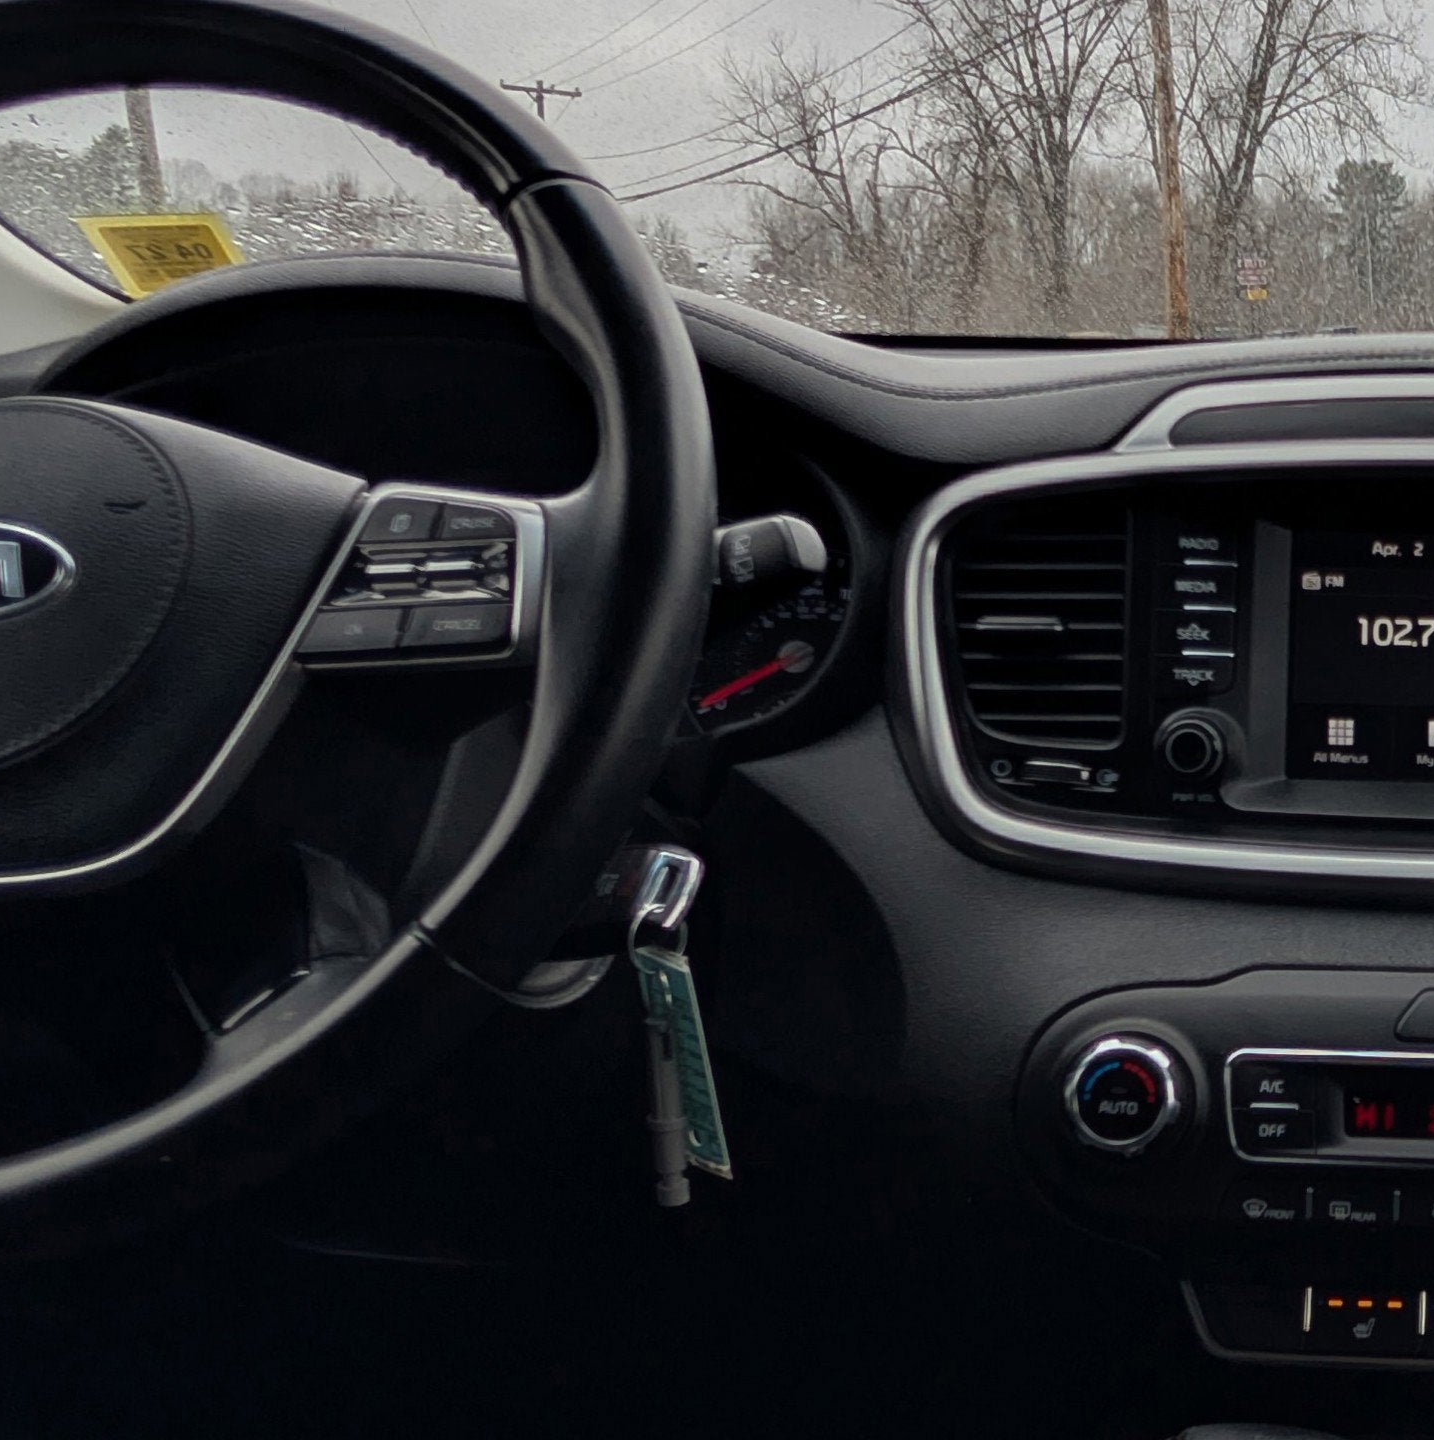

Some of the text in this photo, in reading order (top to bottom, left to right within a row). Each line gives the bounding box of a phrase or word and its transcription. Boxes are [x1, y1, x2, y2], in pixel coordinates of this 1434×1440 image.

[1371, 541, 1424, 558] Apr. 2
[1174, 579, 1218, 594] MEDIA
[1325, 575, 1344, 588] FM
[1329, 753, 1369, 764] Menus
[1416, 754, 1434, 768] My
[1258, 1079, 1286, 1093] A/C
[1098, 1100, 1139, 1116] AUTO
[1258, 1123, 1288, 1138] OFF
